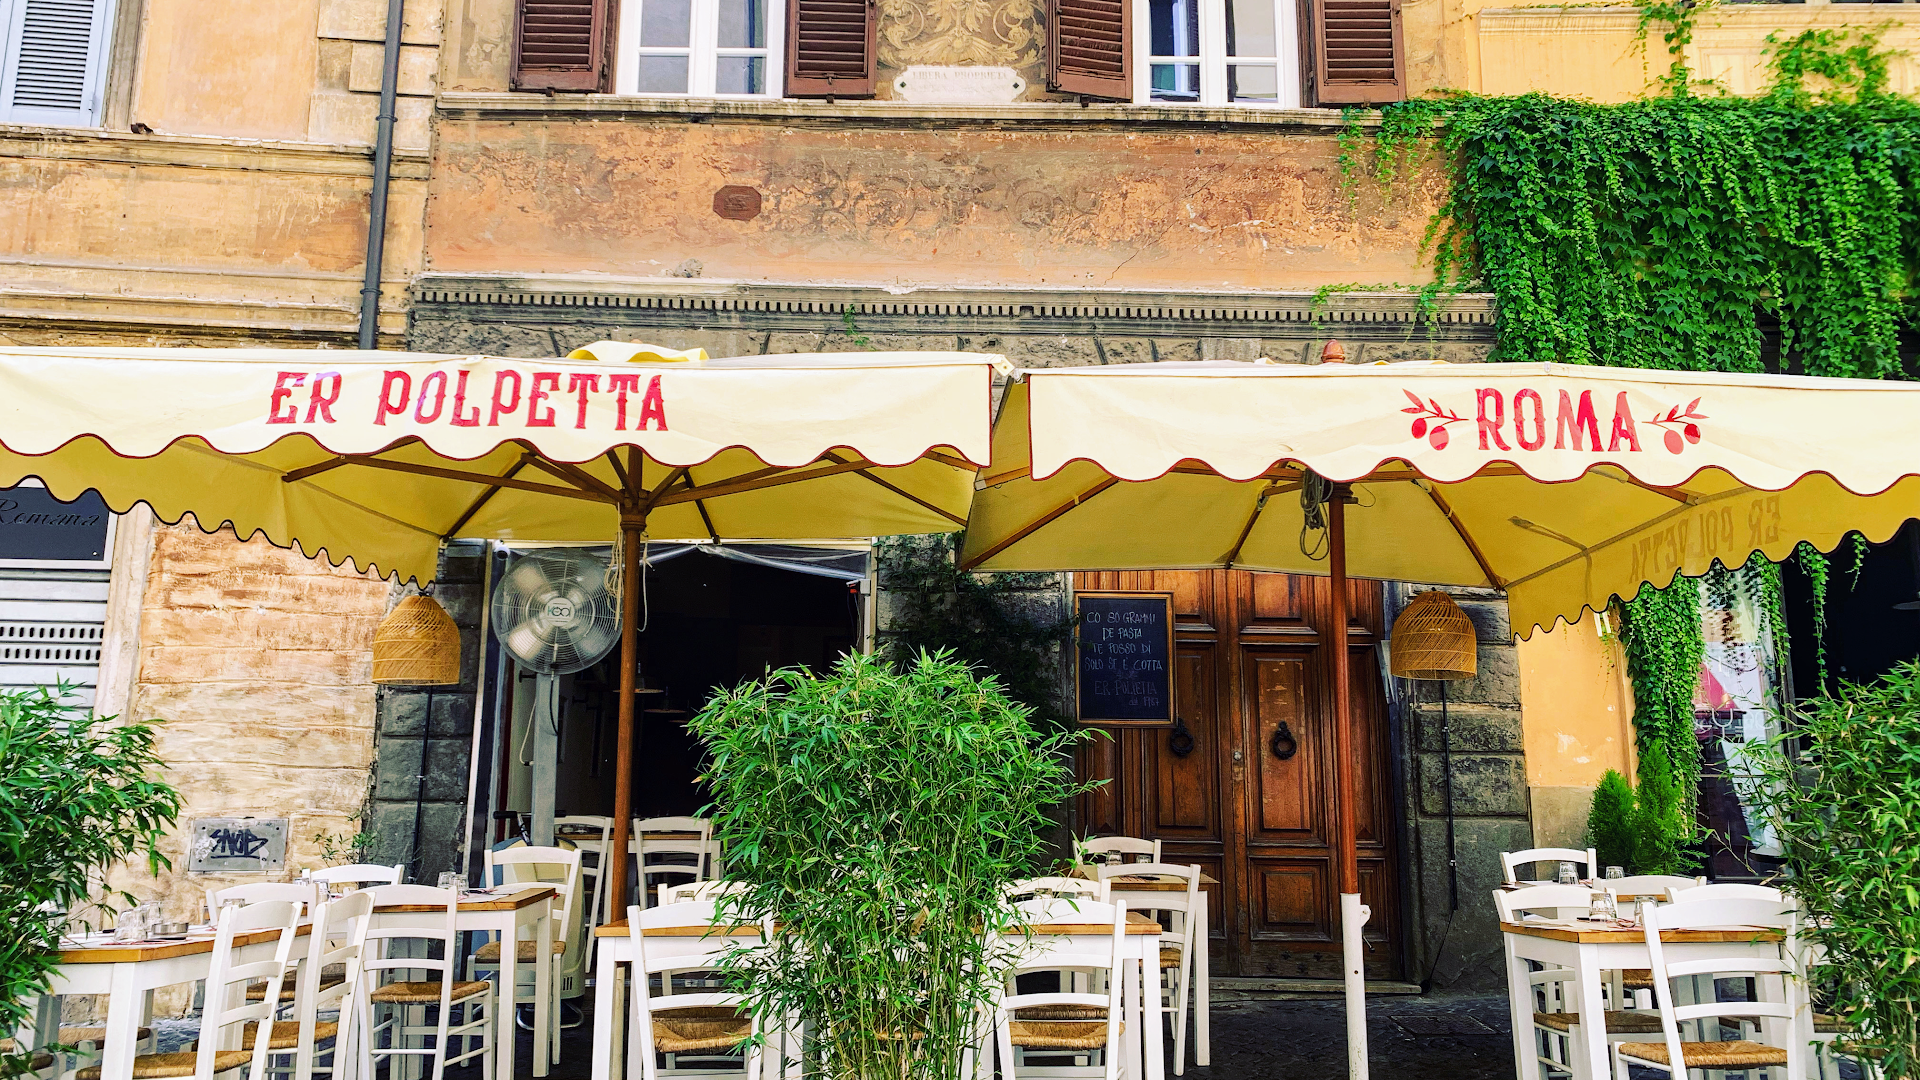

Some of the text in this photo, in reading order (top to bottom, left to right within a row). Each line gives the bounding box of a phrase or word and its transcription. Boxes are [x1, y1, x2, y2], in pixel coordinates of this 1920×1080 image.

[912, 71, 947, 80] LIBERA
[265, 369, 669, 431] ER POLPETTA
[1475, 387, 1643, 453] ROMA
[1107, 612, 1119, 623] 80
[1122, 611, 1156, 624] GRAMMI
[1102, 627, 1142, 641] DE PASTA
[1109, 642, 1136, 654] POSSO
[1084, 656, 1104, 672] SOLO
[1133, 660, 1163, 671] COTTA
[1094, 680, 1111, 696] ER
